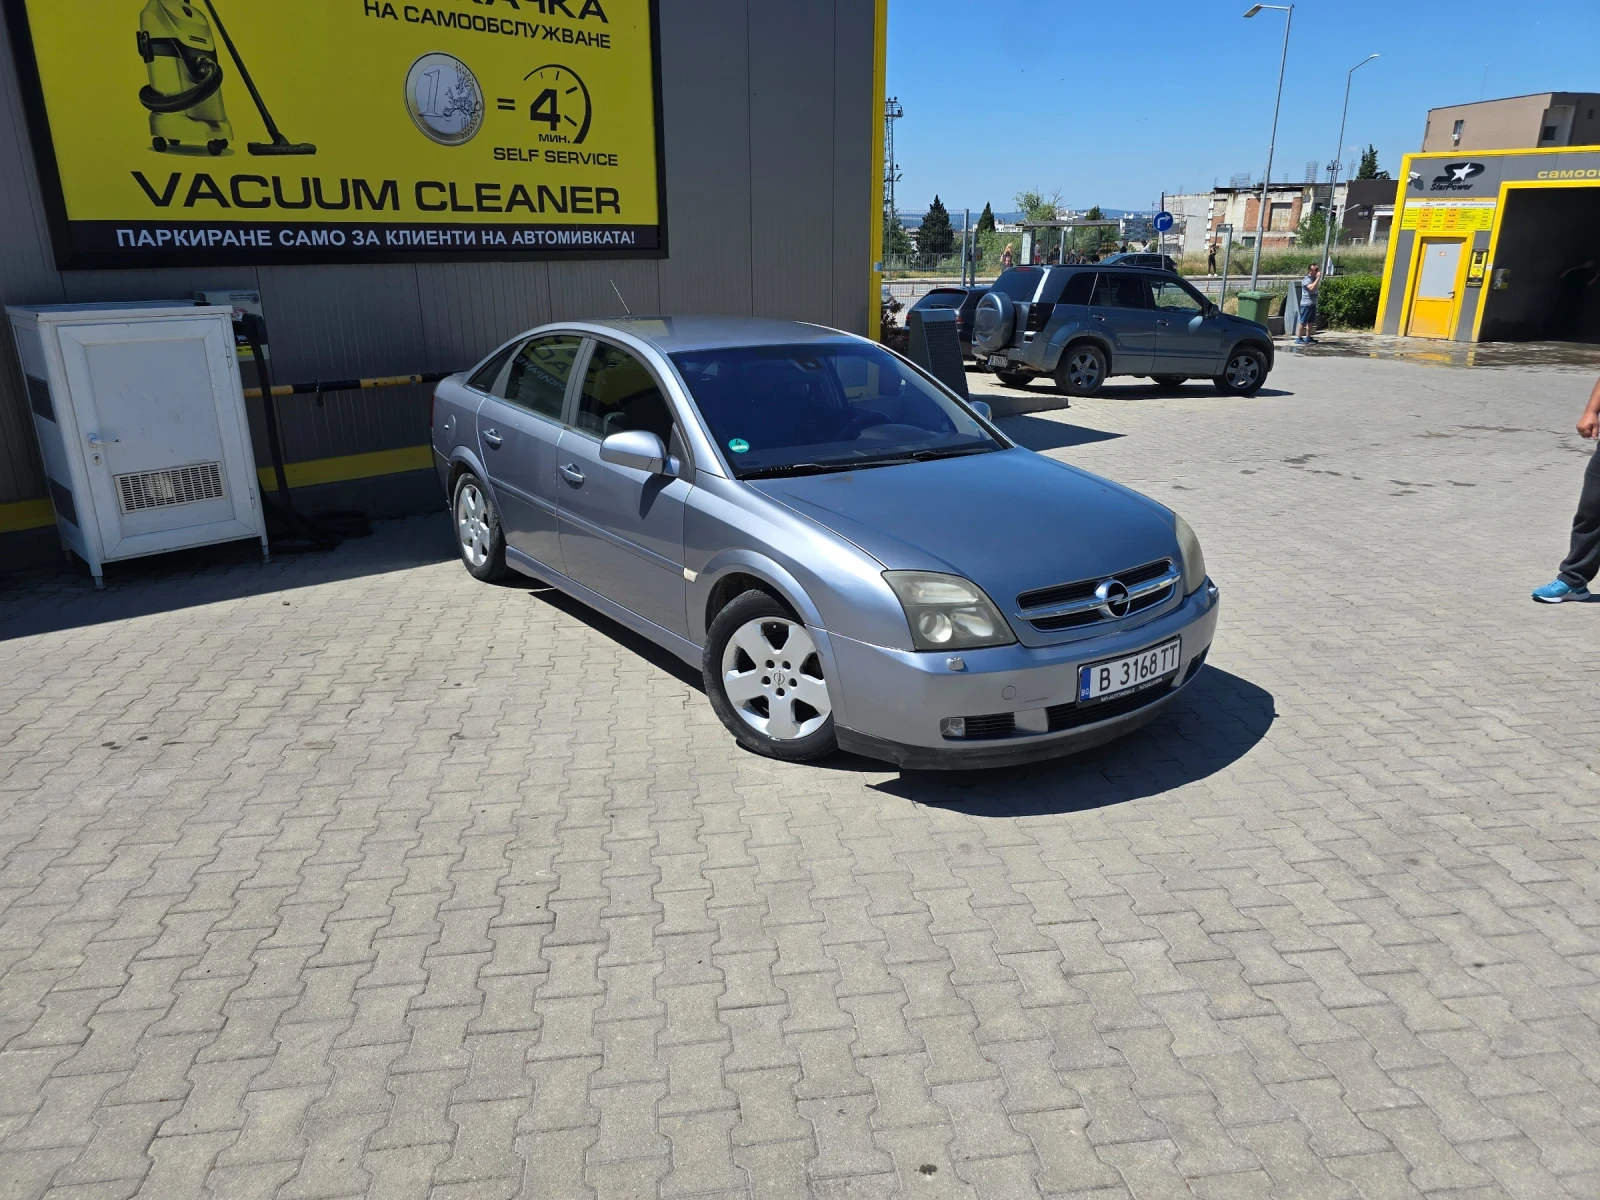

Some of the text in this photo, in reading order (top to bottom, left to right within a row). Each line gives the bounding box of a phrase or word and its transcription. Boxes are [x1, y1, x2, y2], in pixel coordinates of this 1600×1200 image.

[364, 0, 611, 49] НА САМООБСЛУЖВАНЕ
[530, 88, 561, 132] 4
[493, 147, 619, 167] SELF SERVICE
[1430, 182, 1474, 192] StarPower
[1537, 169, 1600, 179] самоо
[130, 170, 621, 215] VACUUM CLEANER
[116, 229, 635, 247] ПАРКИРАНЕ САМО ЗА КЛИЕНТИ НА АВТОМИВКАТА!
[1120, 652, 1158, 686] 3168
